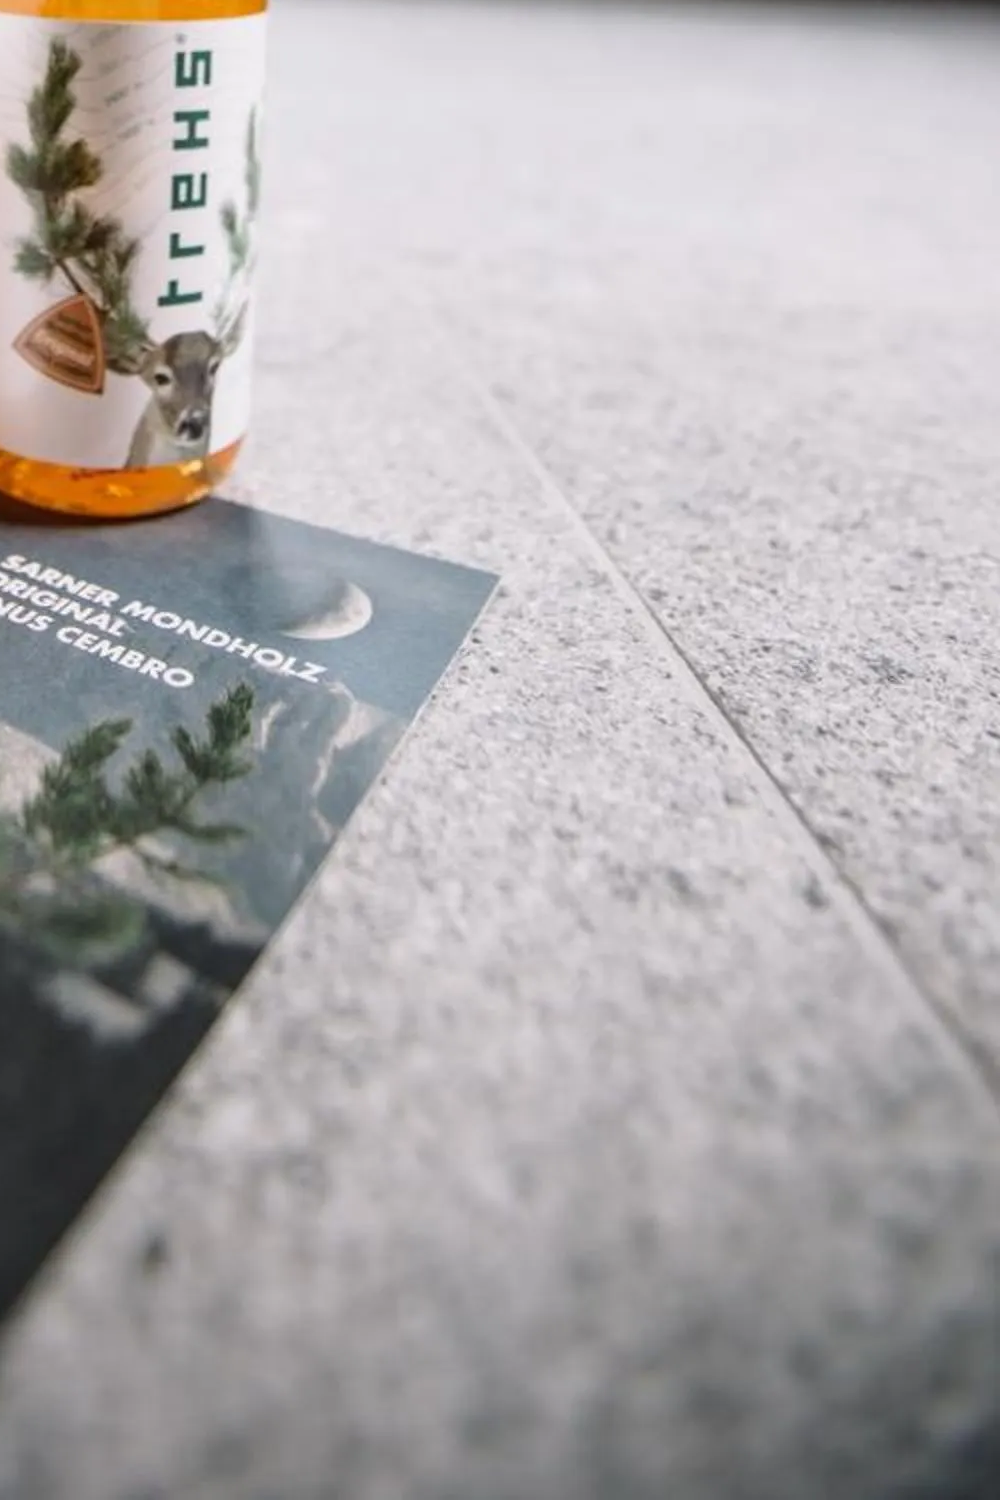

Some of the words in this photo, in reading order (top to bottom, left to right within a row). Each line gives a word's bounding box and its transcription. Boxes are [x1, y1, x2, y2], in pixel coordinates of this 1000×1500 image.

[0, 553, 121, 608] SARNER
[120, 600, 329, 684] MONDHOLZ
[55, 626, 195, 688] CEMBRO
